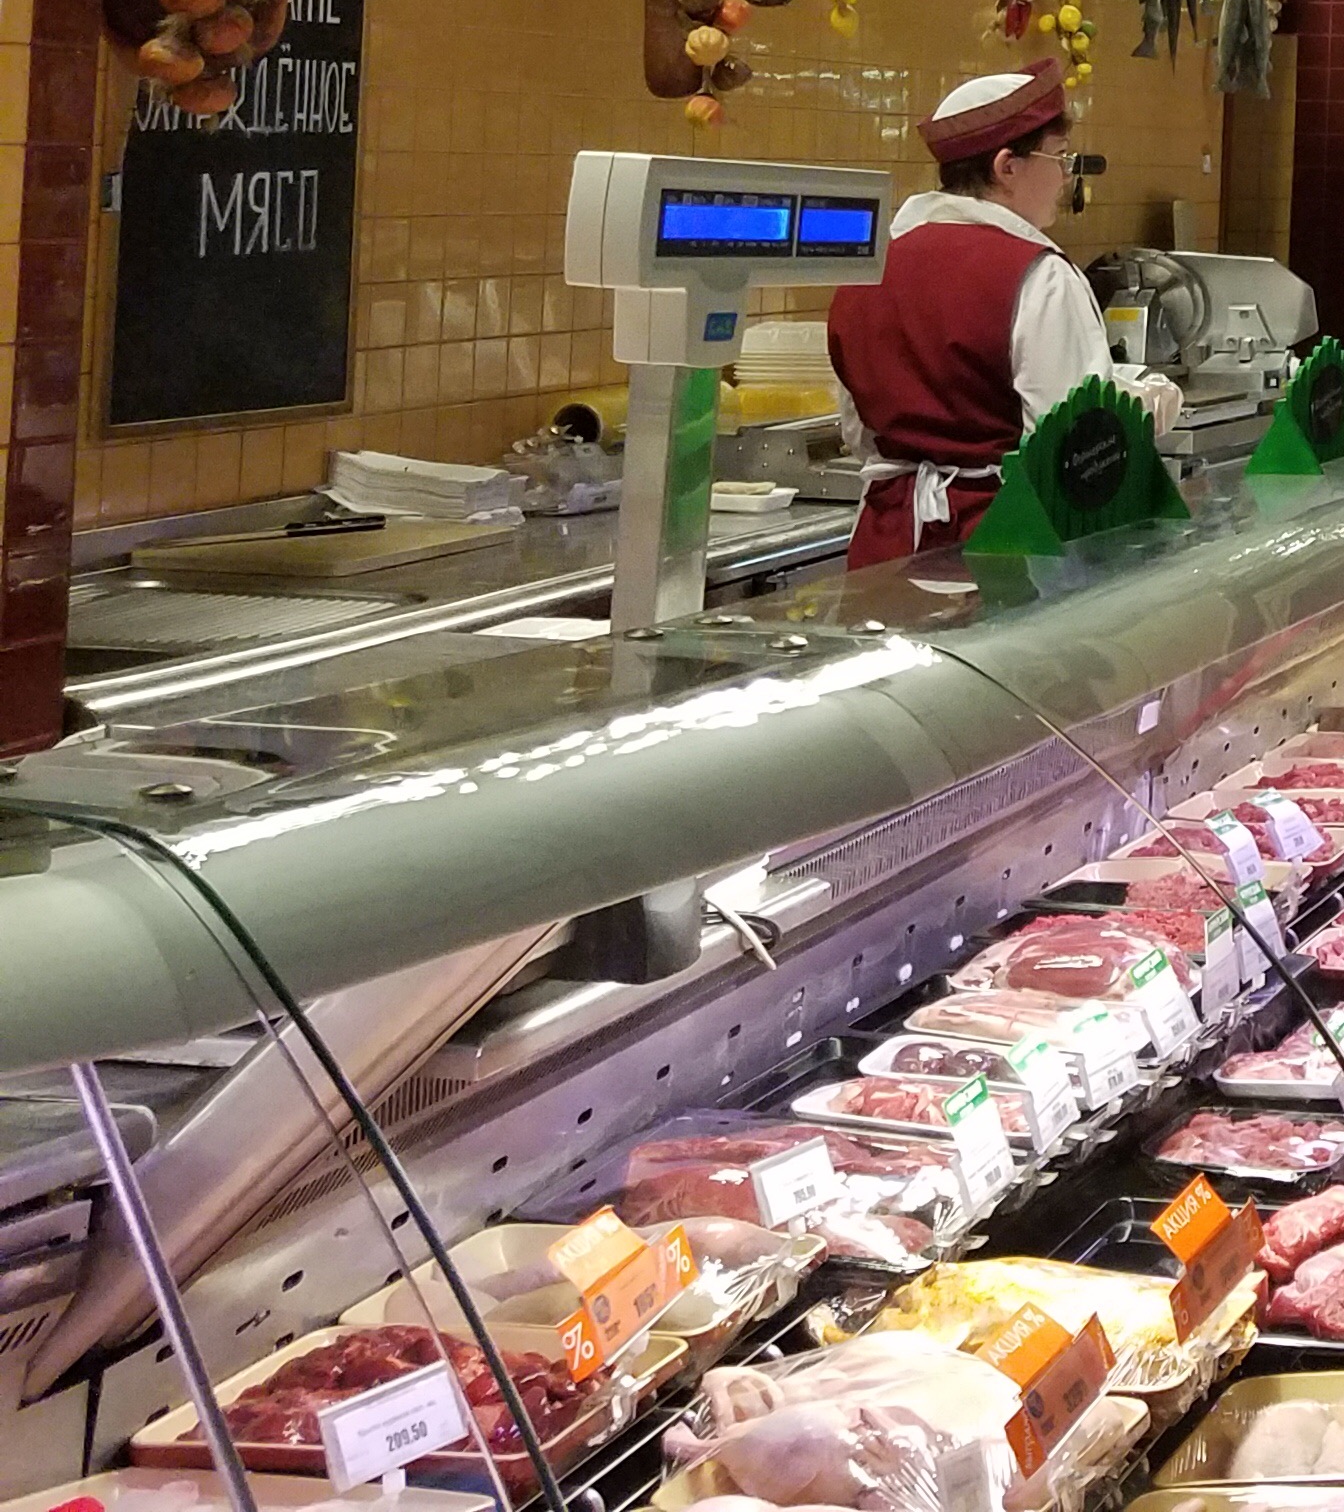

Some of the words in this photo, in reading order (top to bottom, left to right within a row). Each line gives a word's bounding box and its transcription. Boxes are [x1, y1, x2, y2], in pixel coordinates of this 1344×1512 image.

[199, 170, 318, 258] МЯСО
[1162, 1194, 1201, 1240] АКЦИЯ
[987, 1319, 1028, 1367] АКЦИЯ
[385, 1420, 428, 1452] 209.50
